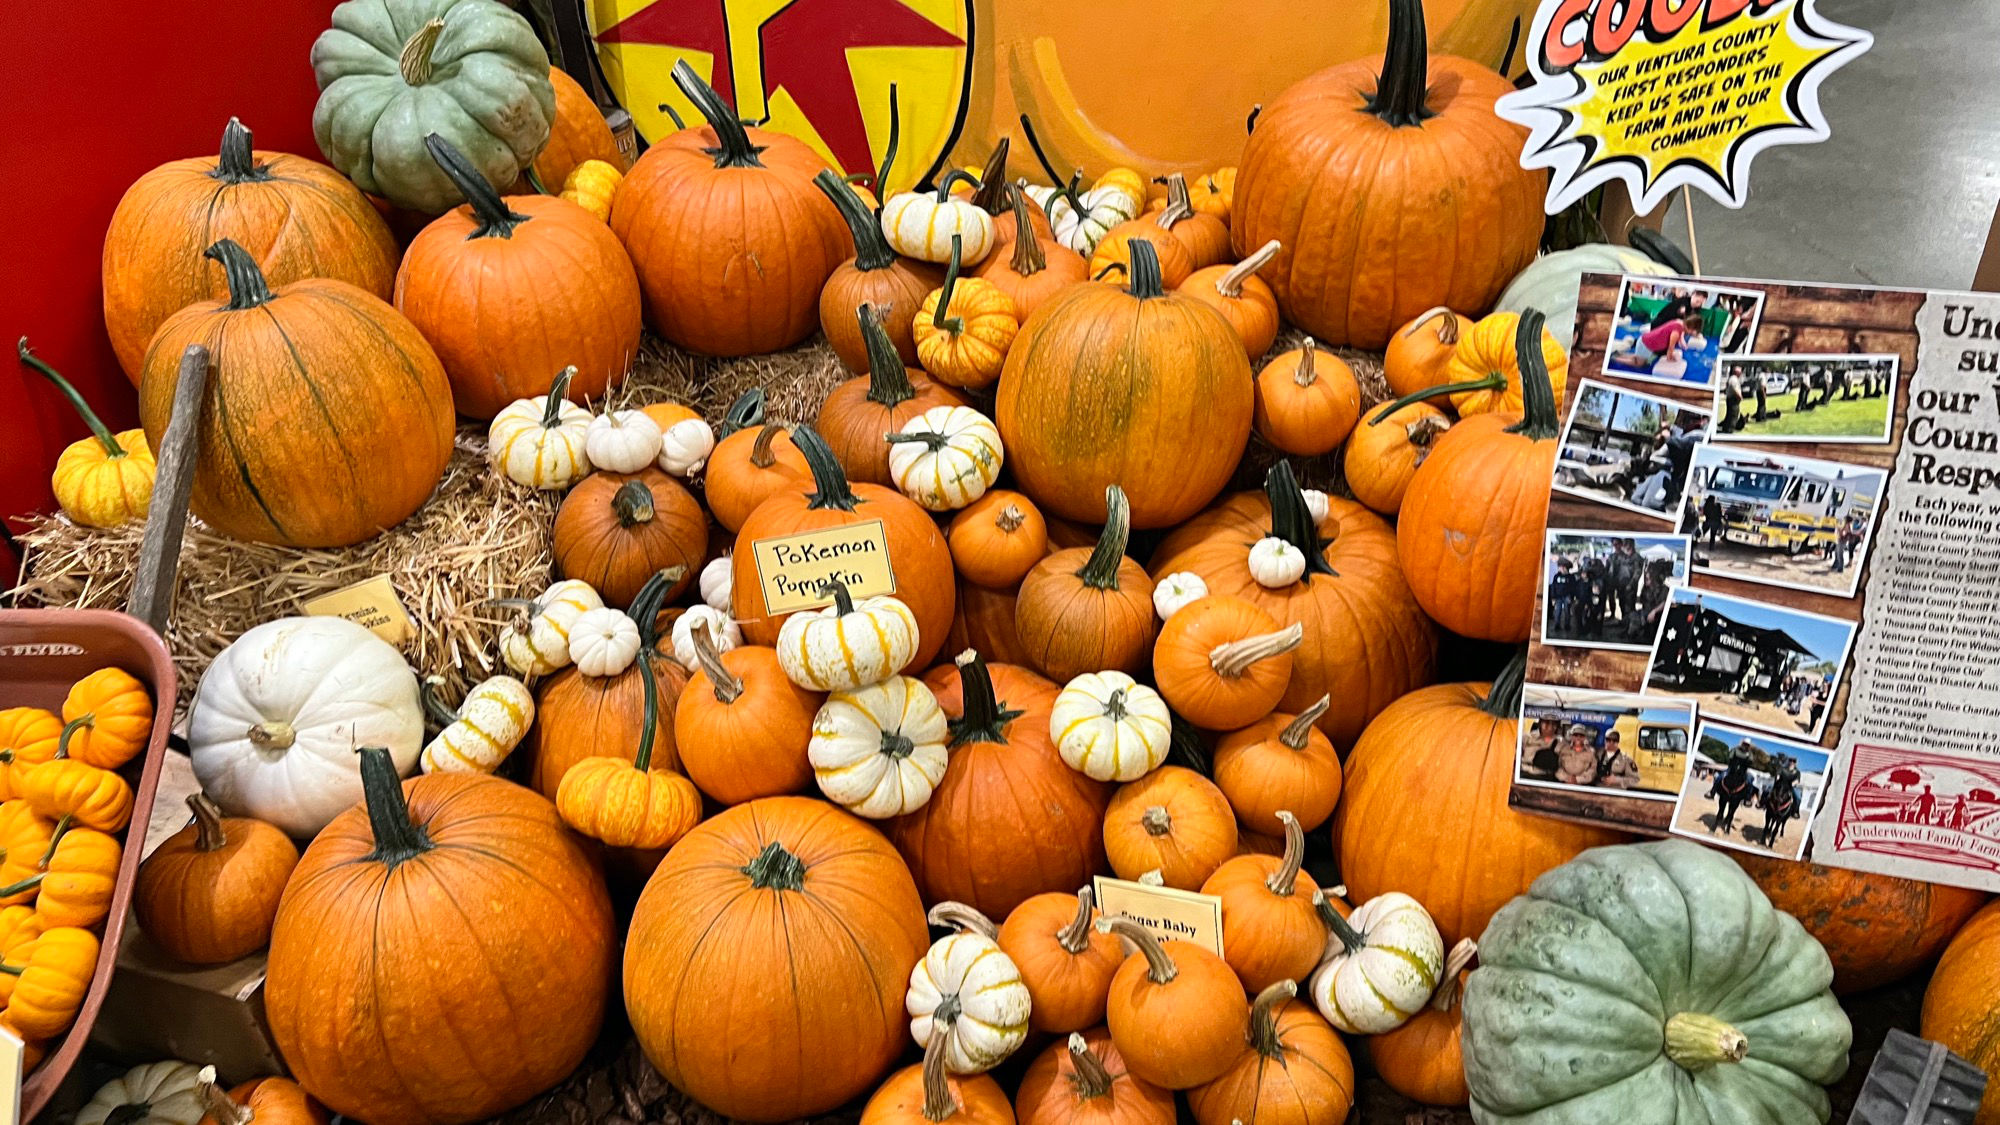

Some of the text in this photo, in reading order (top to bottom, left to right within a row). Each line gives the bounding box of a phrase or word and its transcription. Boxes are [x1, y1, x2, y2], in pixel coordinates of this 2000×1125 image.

[1598, 21, 1781, 87] OUR VENTURA COUNTY
[1613, 45, 1769, 104] FIRST RESPONDERS
[1606, 61, 1784, 125] KEEP US SAFE ON THE
[1624, 87, 1771, 140] FARM AND IN OUR
[1651, 115, 1749, 152] COMMUNITY.
[1958, 349, 2000, 376] su
[1917, 389, 1980, 414] our
[1908, 416, 1998, 453] Coun
[1915, 495, 1947, 510] Each
[1950, 499, 1984, 516] year,
[1899, 510, 1921, 524] the
[1925, 513, 1992, 534] following
[1903, 526, 1938, 540] Ventura
[1941, 531, 1972, 545] County
[1900, 540, 1935, 552] Ventura
[1938, 544, 1970, 558] County
[1898, 553, 1999, 573] Ventura County Sheriff
[1895, 566, 1930, 579] Ventura
[1931, 570, 1964, 584] County
[1966, 573, 1997, 586] Sheriff
[1892, 579, 1927, 592] Ventura
[1929, 583, 1961, 598] County
[1962, 587, 1992, 600] Search
[1889, 592, 1924, 605] Ventura
[1926, 595, 1958, 609] County
[1960, 600, 1989, 612] Sheriff
[1886, 605, 1921, 617] Ventura
[1923, 608, 1955, 622] County
[1957, 612, 1987, 624] Sheriff
[1884, 617, 1927, 631] Thousand
[1928, 622, 1949, 634] Oaks
[1952, 625, 1978, 637] Police
[1881, 630, 1916, 643] Ventura
[1917, 635, 1948, 649] County
[1950, 639, 1968, 649] Fire
[1879, 643, 1914, 656] Ventura
[1915, 648, 1947, 662] County
[1948, 651, 1965, 661] Fire
[1875, 656, 1983, 677] Antique Fire Engine Club
[1872, 680, 1927, 696] Team (DART)
[1873, 668, 1916, 682] Thousand
[1917, 674, 1938, 684] Oaks
[1940, 676, 1975, 689] Disaster
[1869, 692, 1911, 706] Thousand
[1912, 698, 1932, 708] Oaks
[1935, 700, 1960, 712] Police
[1872, 705, 1928, 721] Safe Passage
[1863, 715, 1898, 729] Ventura
[1899, 721, 1925, 732] Police
[1926, 724, 1980, 740] Department
[1860, 728, 1892, 741] Oxnard
[1893, 732, 1919, 743] Police
[1920, 736, 1974, 752] Department
[1853, 825, 1922, 840] Underwood
[1927, 830, 1966, 848] Family
[1163, 918, 1196, 938] Baby
